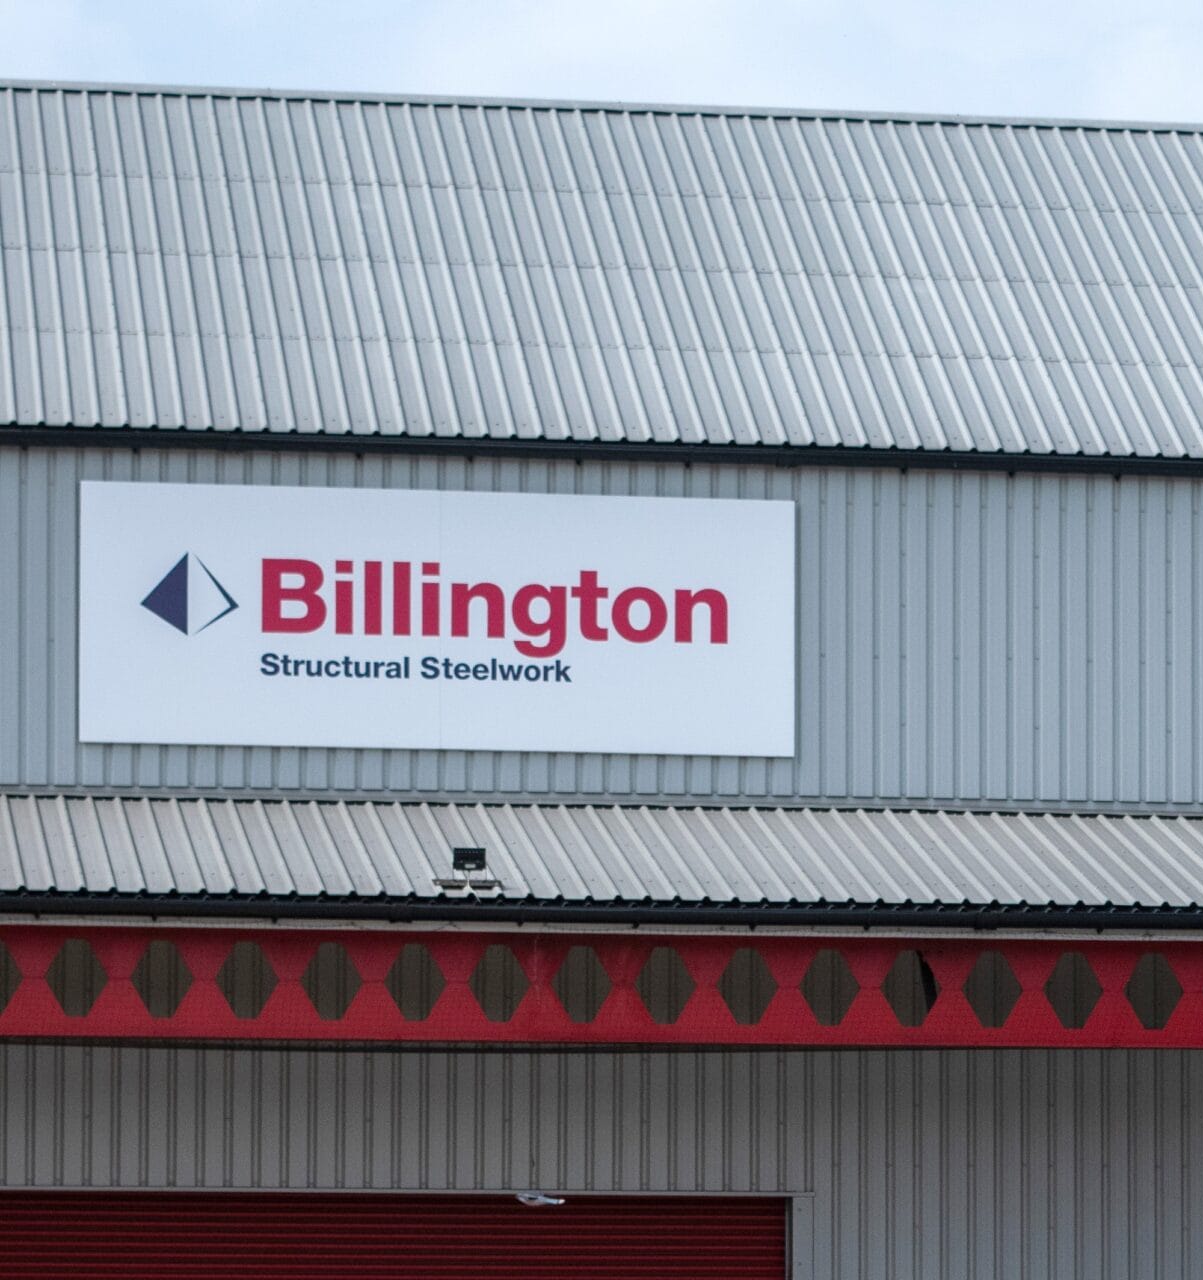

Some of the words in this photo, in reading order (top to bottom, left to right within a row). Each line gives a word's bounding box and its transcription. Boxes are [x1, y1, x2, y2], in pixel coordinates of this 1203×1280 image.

[262, 557, 728, 658] Billington
[260, 653, 410, 680] Structural
[420, 655, 572, 683] Steelwork
